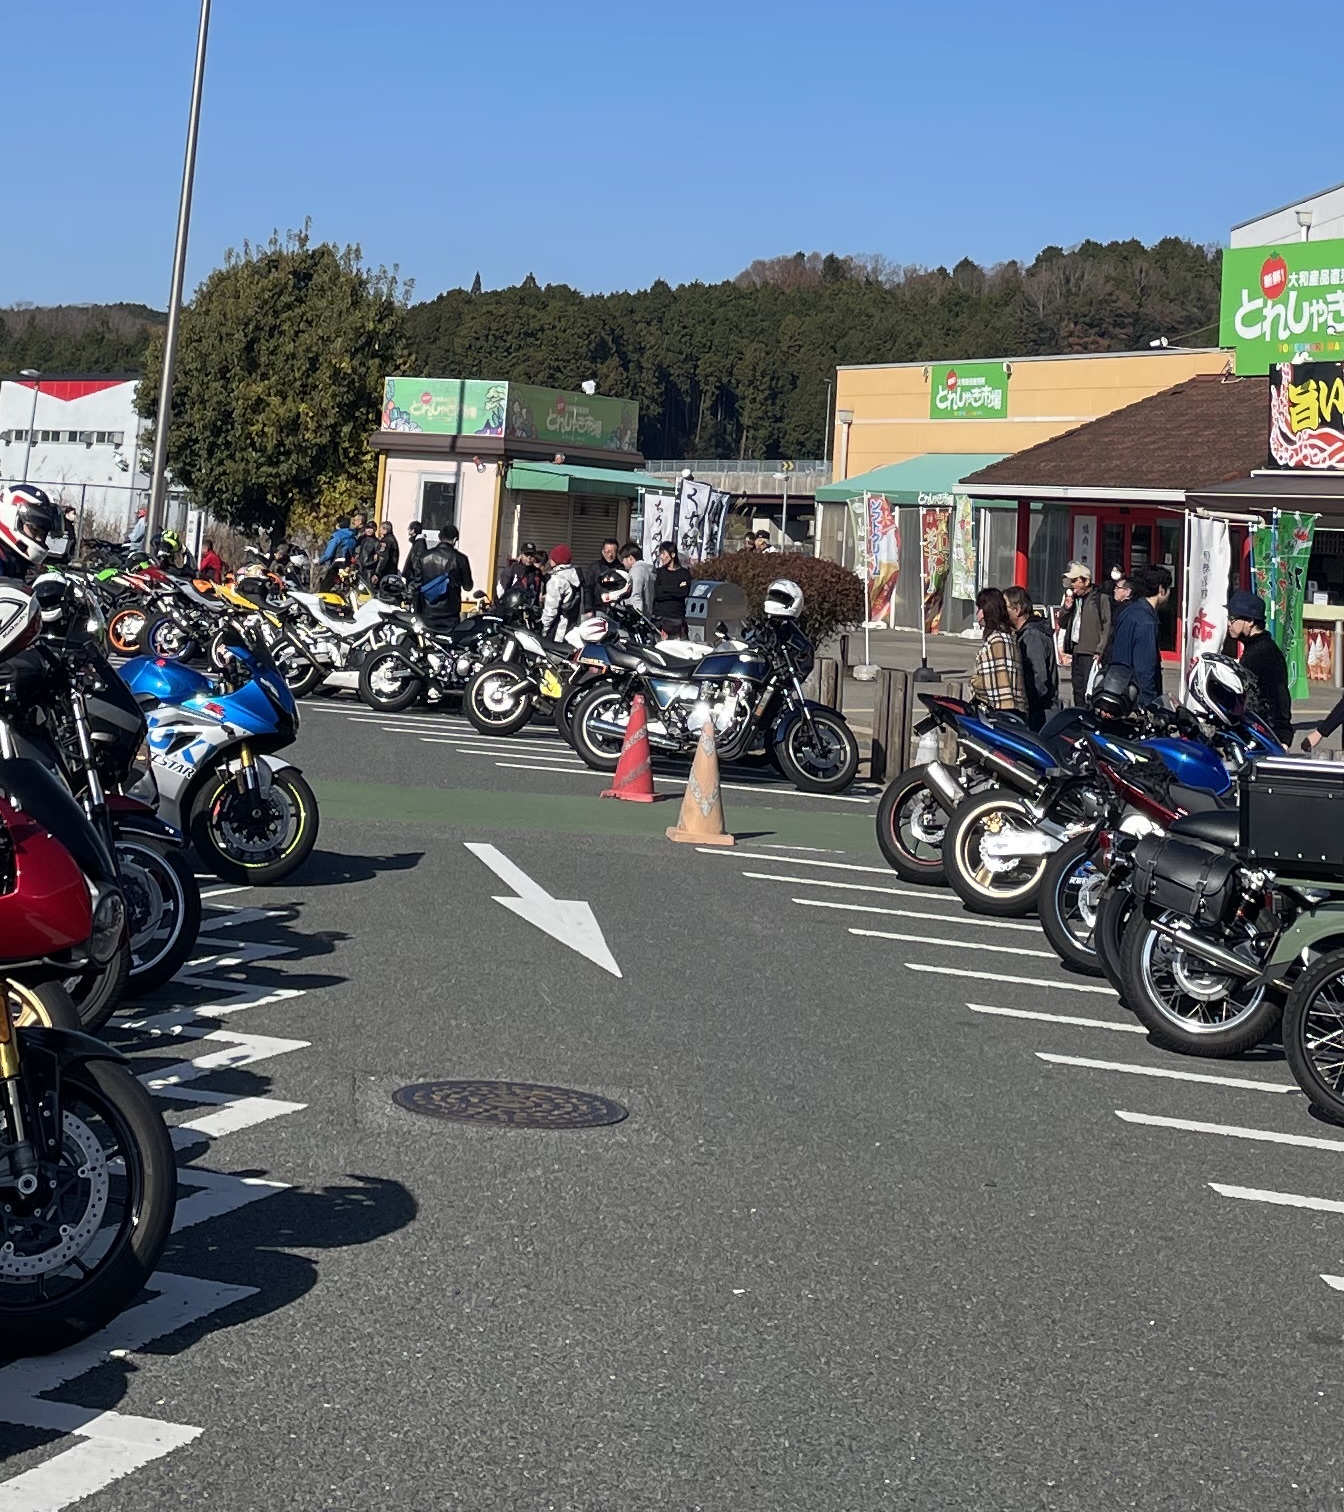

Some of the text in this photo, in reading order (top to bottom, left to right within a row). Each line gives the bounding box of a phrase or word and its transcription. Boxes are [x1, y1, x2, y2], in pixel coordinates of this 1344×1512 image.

[869, 498, 883, 576] ソフトクリーム
